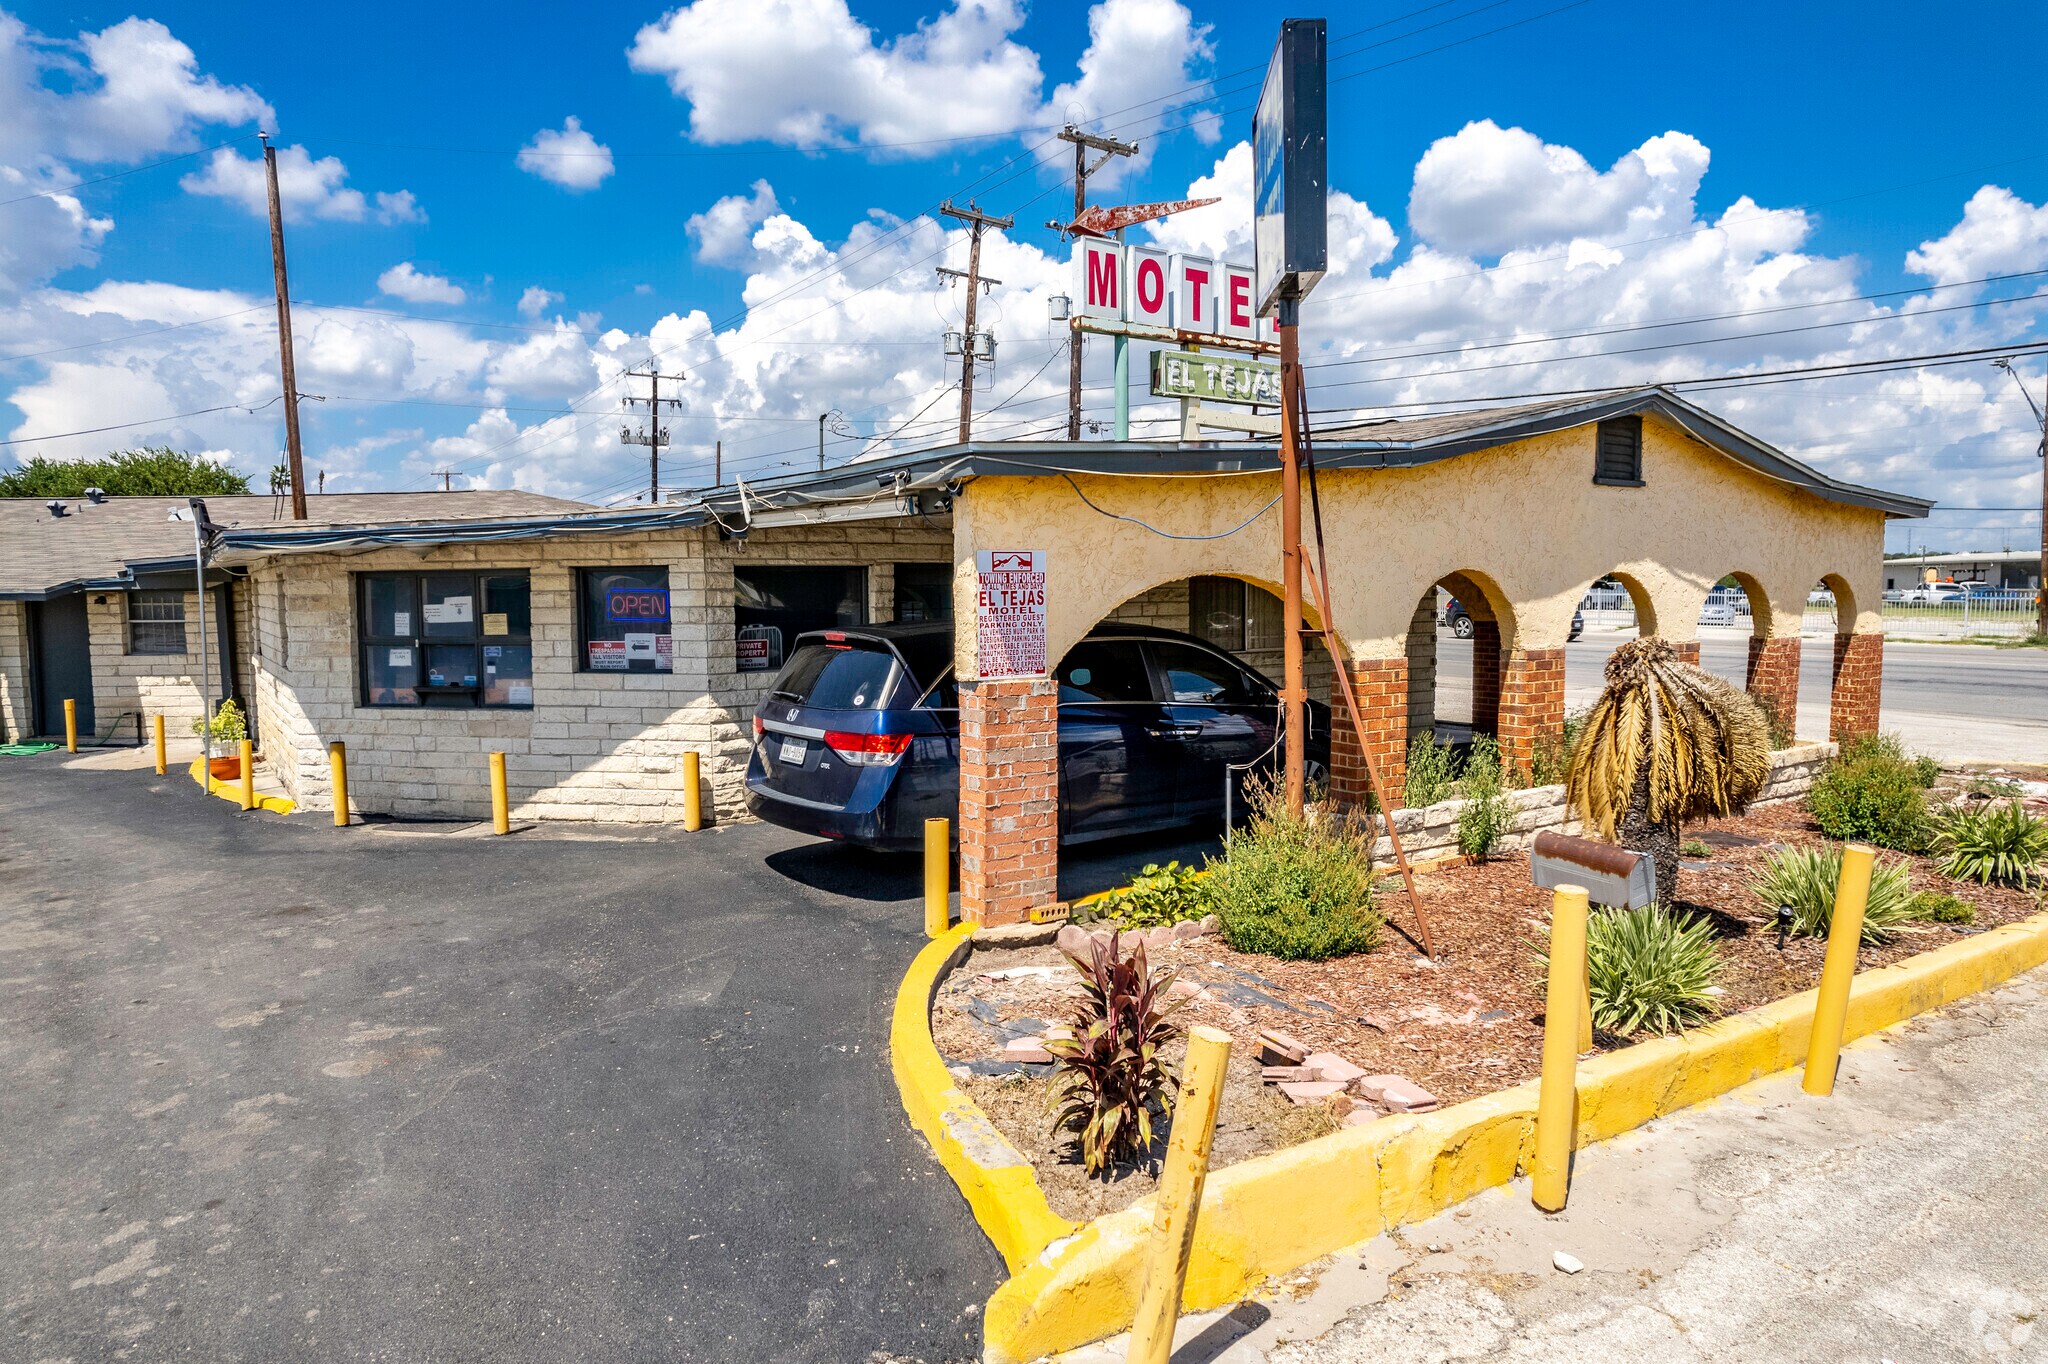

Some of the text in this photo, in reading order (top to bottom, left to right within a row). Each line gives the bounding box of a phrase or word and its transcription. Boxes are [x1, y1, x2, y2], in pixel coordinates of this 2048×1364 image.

[1088, 250, 1281, 333] MOTE
[1167, 357, 1282, 403] EL TEJAS
[982, 572, 1044, 583] TOWING ENFORCED
[1030, 582, 1044, 590] DAYS
[980, 590, 1044, 606] EL TEJAS
[611, 595, 666, 615] OPEN
[988, 606, 1036, 615] MOTEL
[980, 613, 1044, 622] REGISTERED GUEST
[980, 629, 989, 637] ALL
[990, 628, 1012, 636] VEHICLES
[1013, 627, 1025, 635] MUST
[1027, 627, 1038, 635] PARK
[984, 635, 1011, 643] DESIGNATED
[988, 642, 1020, 650] INOPERABLE
[1021, 641, 1046, 649] VEHICLES
[736, 649, 766, 657] ROPERTY
[980, 648, 1045, 657] UNAUTHORIZED VEHICLES
[1000, 655, 1016, 663] TOWED
[988, 661, 1020, 669] OPERATOR'S
